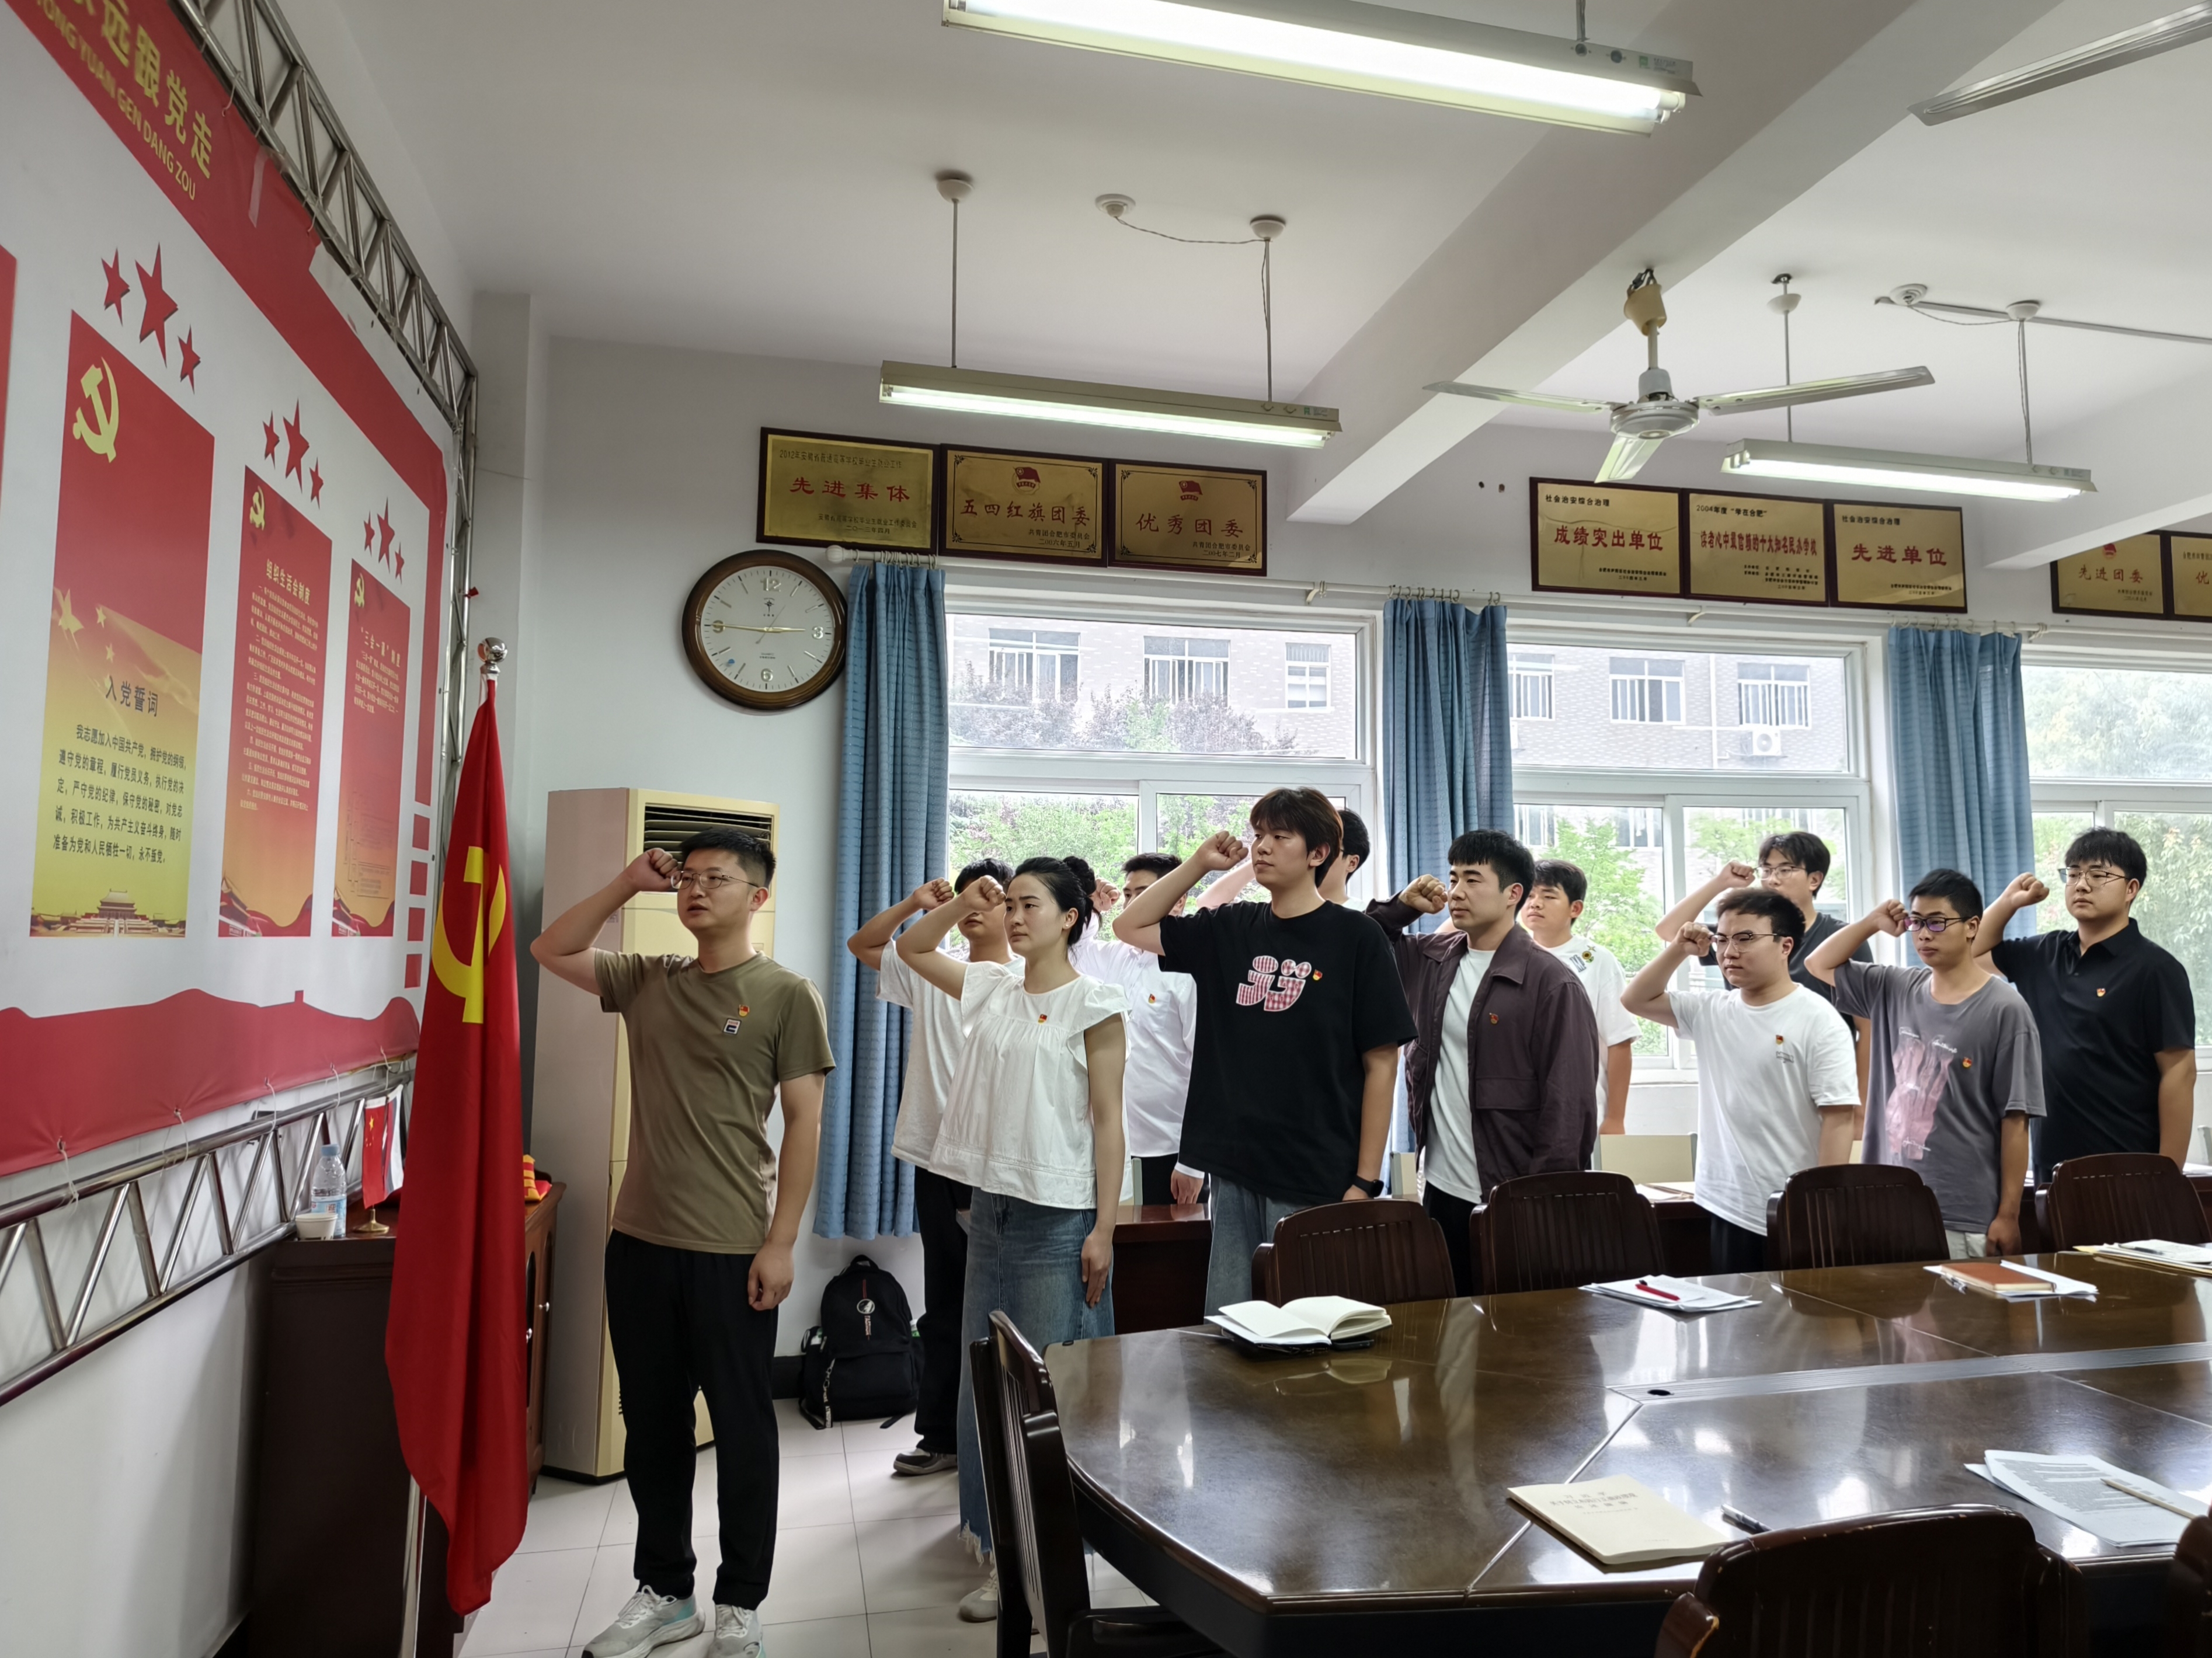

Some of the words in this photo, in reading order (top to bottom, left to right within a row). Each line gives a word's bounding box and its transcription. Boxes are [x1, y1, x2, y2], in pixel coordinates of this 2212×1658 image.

[37, 0, 76, 49] ONG
[117, 88, 142, 131] GEN
[143, 120, 173, 173] DANG
[175, 161, 195, 200] ZOU
[73, 0, 212, 179] 远跟党走
[789, 476, 910, 502] 先进集体
[1545, 494, 1610, 507] 社会治安综合治理
[960, 499, 1090, 527] 五四红旗团委
[1842, 515, 1901, 525] 社会治安综合治理
[1028, 528, 1090, 541] 共青团合肥市委员会
[1136, 513, 1243, 538] 优秀团委
[1192, 541, 1251, 552] 共青团合肥市委员会
[1554, 525, 1663, 551] 成绩突出单位
[1851, 543, 1947, 566] 先进单位
[266, 559, 310, 606] 组织生活会制度
[2078, 564, 2144, 584] 先进团委
[760, 577, 781, 593] 12
[712, 619, 725, 634] 9
[811, 626, 824, 640] 3
[760, 667, 774, 682] 6
[106, 675, 158, 717] 入党誓词
